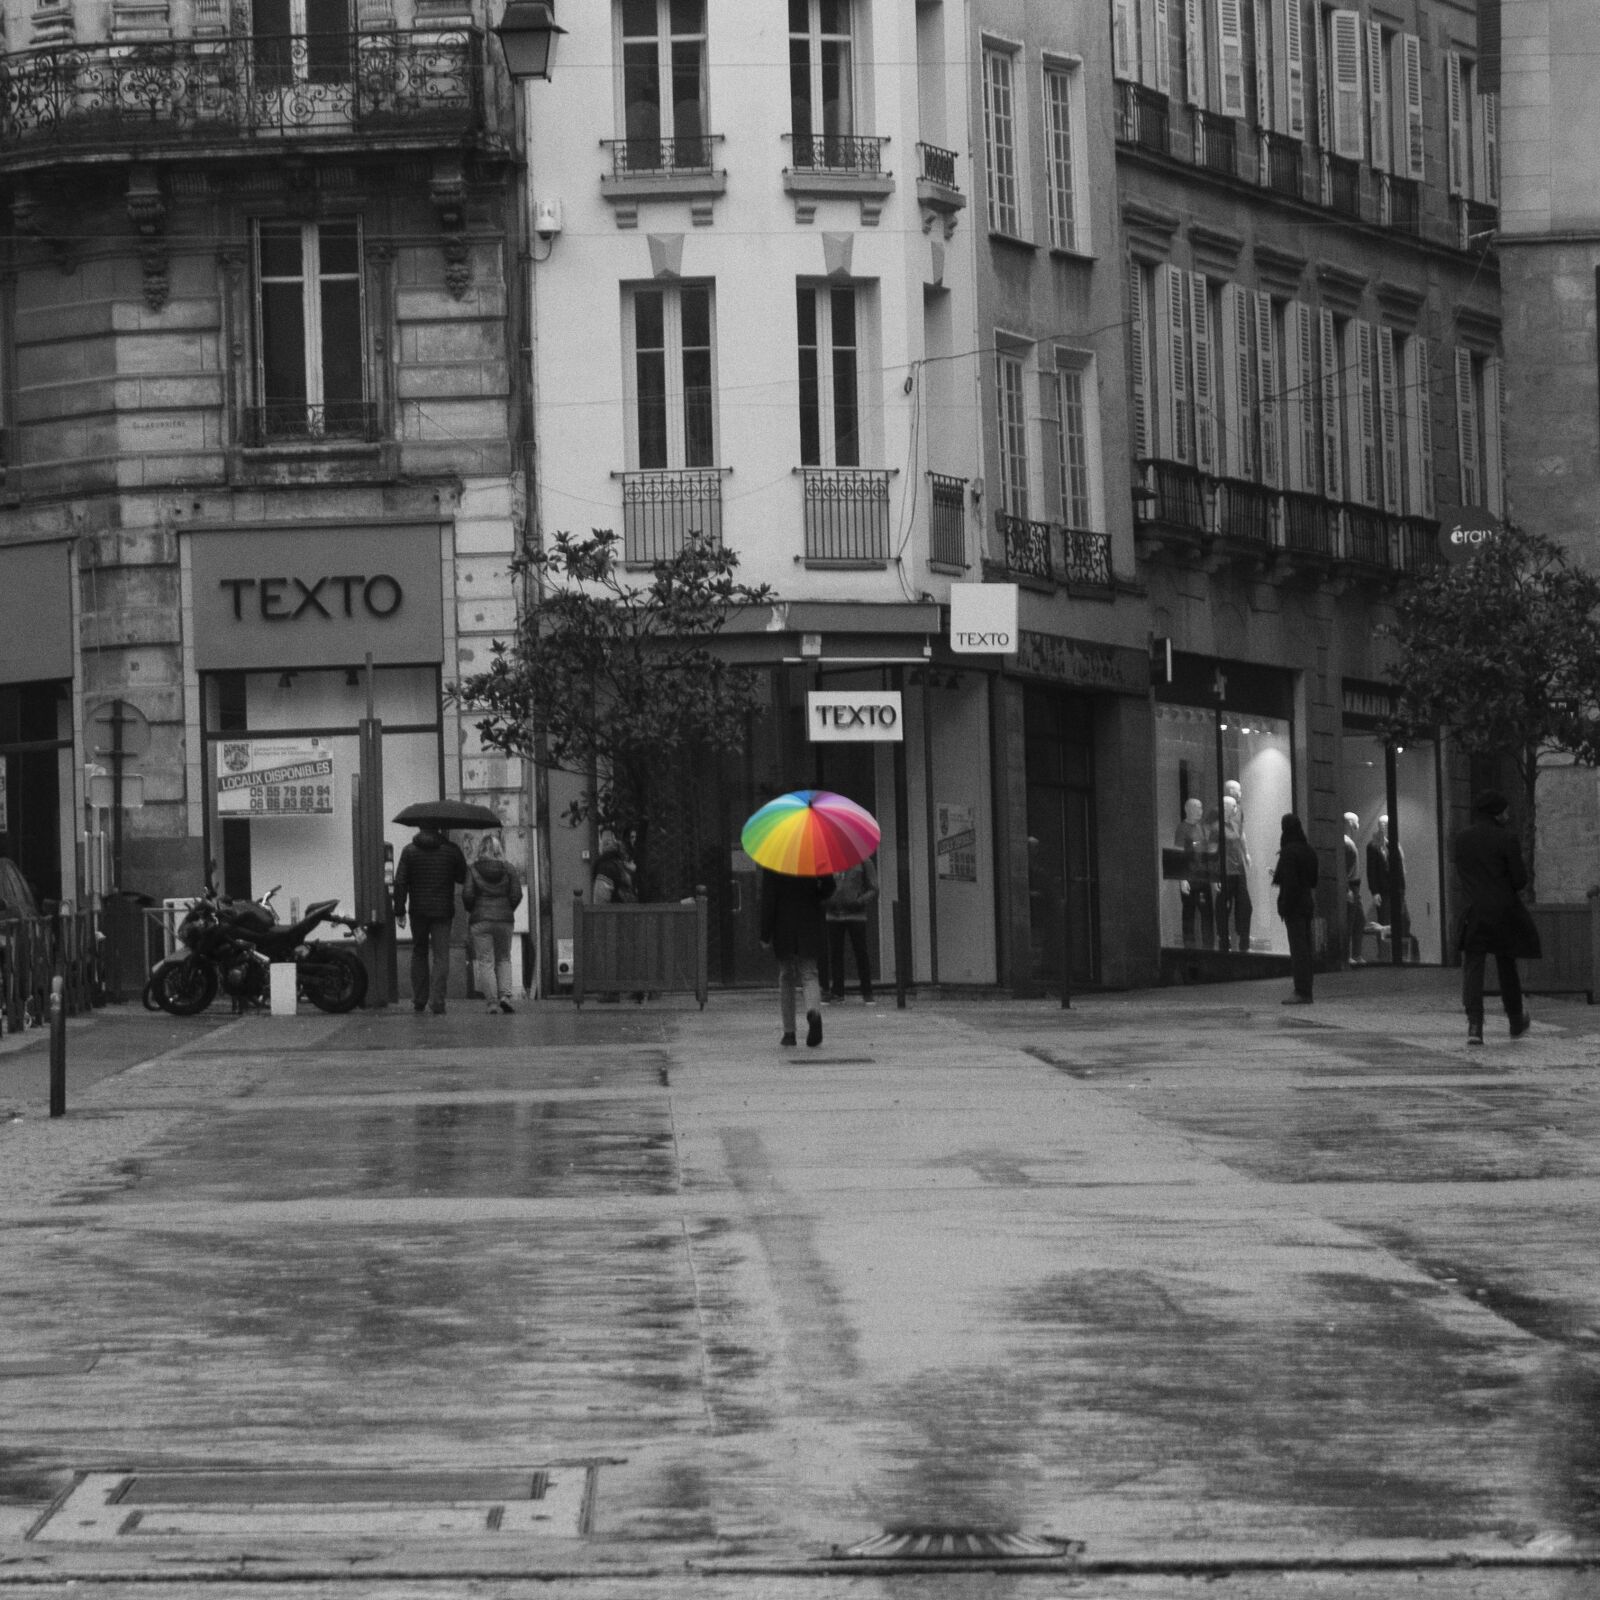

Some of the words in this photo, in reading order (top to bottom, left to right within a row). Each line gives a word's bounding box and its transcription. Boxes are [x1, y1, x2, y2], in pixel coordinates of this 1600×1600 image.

[220, 574, 403, 621] TEXTO
[957, 632, 1009, 647] TEXTO
[816, 704, 897, 730] TEXTO
[222, 773, 263, 790] LOCAUX
[264, 761, 330, 783] DISPONIBLES
[249, 786, 264, 798] 05
